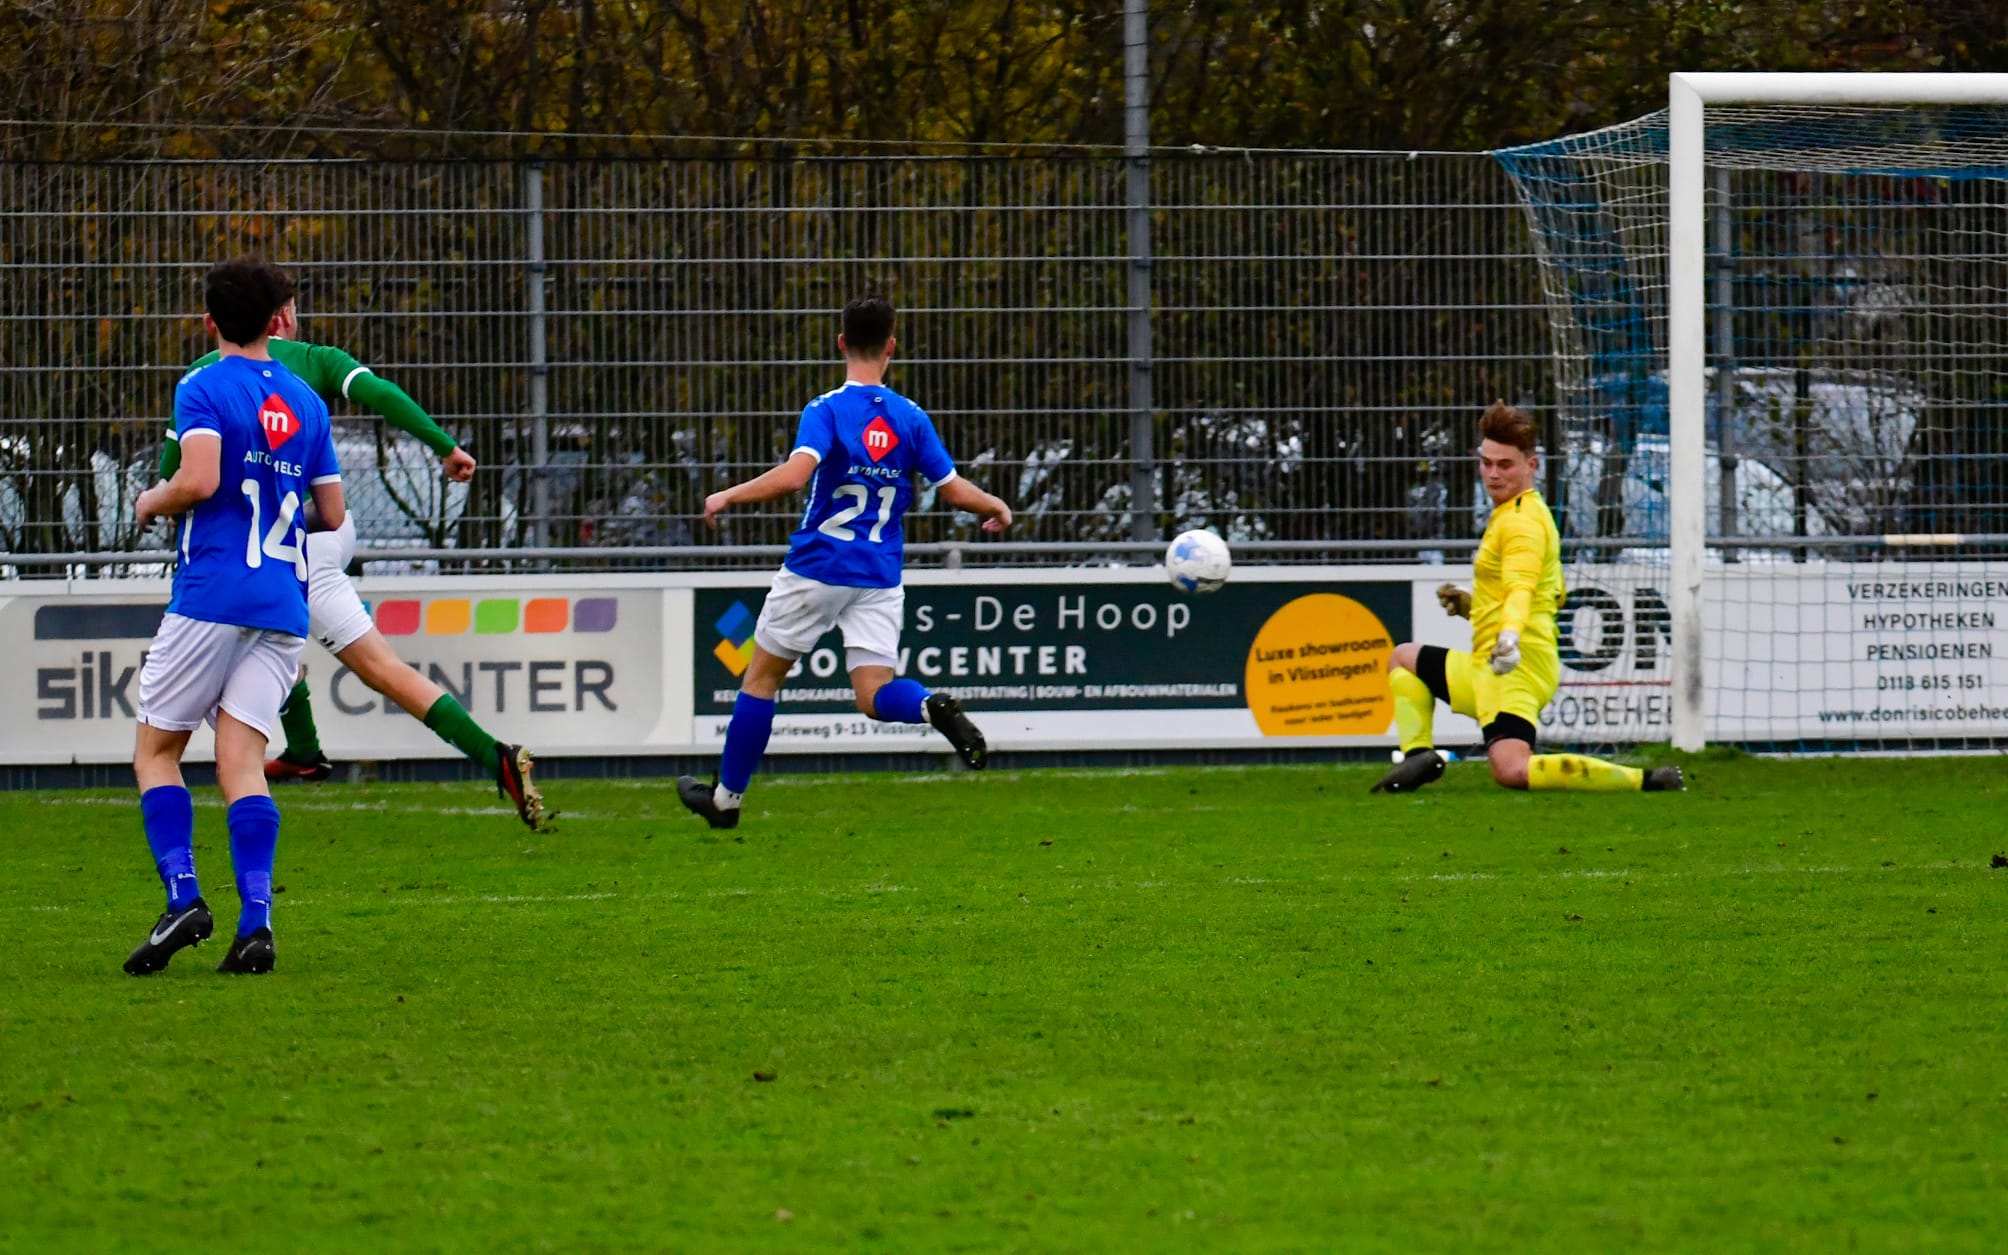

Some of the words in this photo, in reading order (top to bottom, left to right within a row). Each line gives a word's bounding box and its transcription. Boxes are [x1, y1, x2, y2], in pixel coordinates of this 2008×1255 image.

[868, 430, 889, 448] m
[818, 484, 897, 543] 21
[241, 479, 308, 582] 14
[1847, 581, 2008, 599] VERZEKERINGEN
[1058, 595, 1190, 637] Hoop
[1863, 612, 1996, 630] HYPOTHEKEN
[1255, 647, 1294, 662] Luxe
[1299, 637, 1388, 658] showroom
[1867, 643, 1993, 661] PENSIOENEN
[1268, 669, 1284, 684] in
[1287, 659, 1379, 682] Vlissingen!
[1921, 675, 1950, 690] 615
[1957, 675, 1983, 689] 151
[770, 724, 830, 738] urieweg
[834, 722, 866, 735] 9-13
[871, 722, 935, 737] Vlissinge
